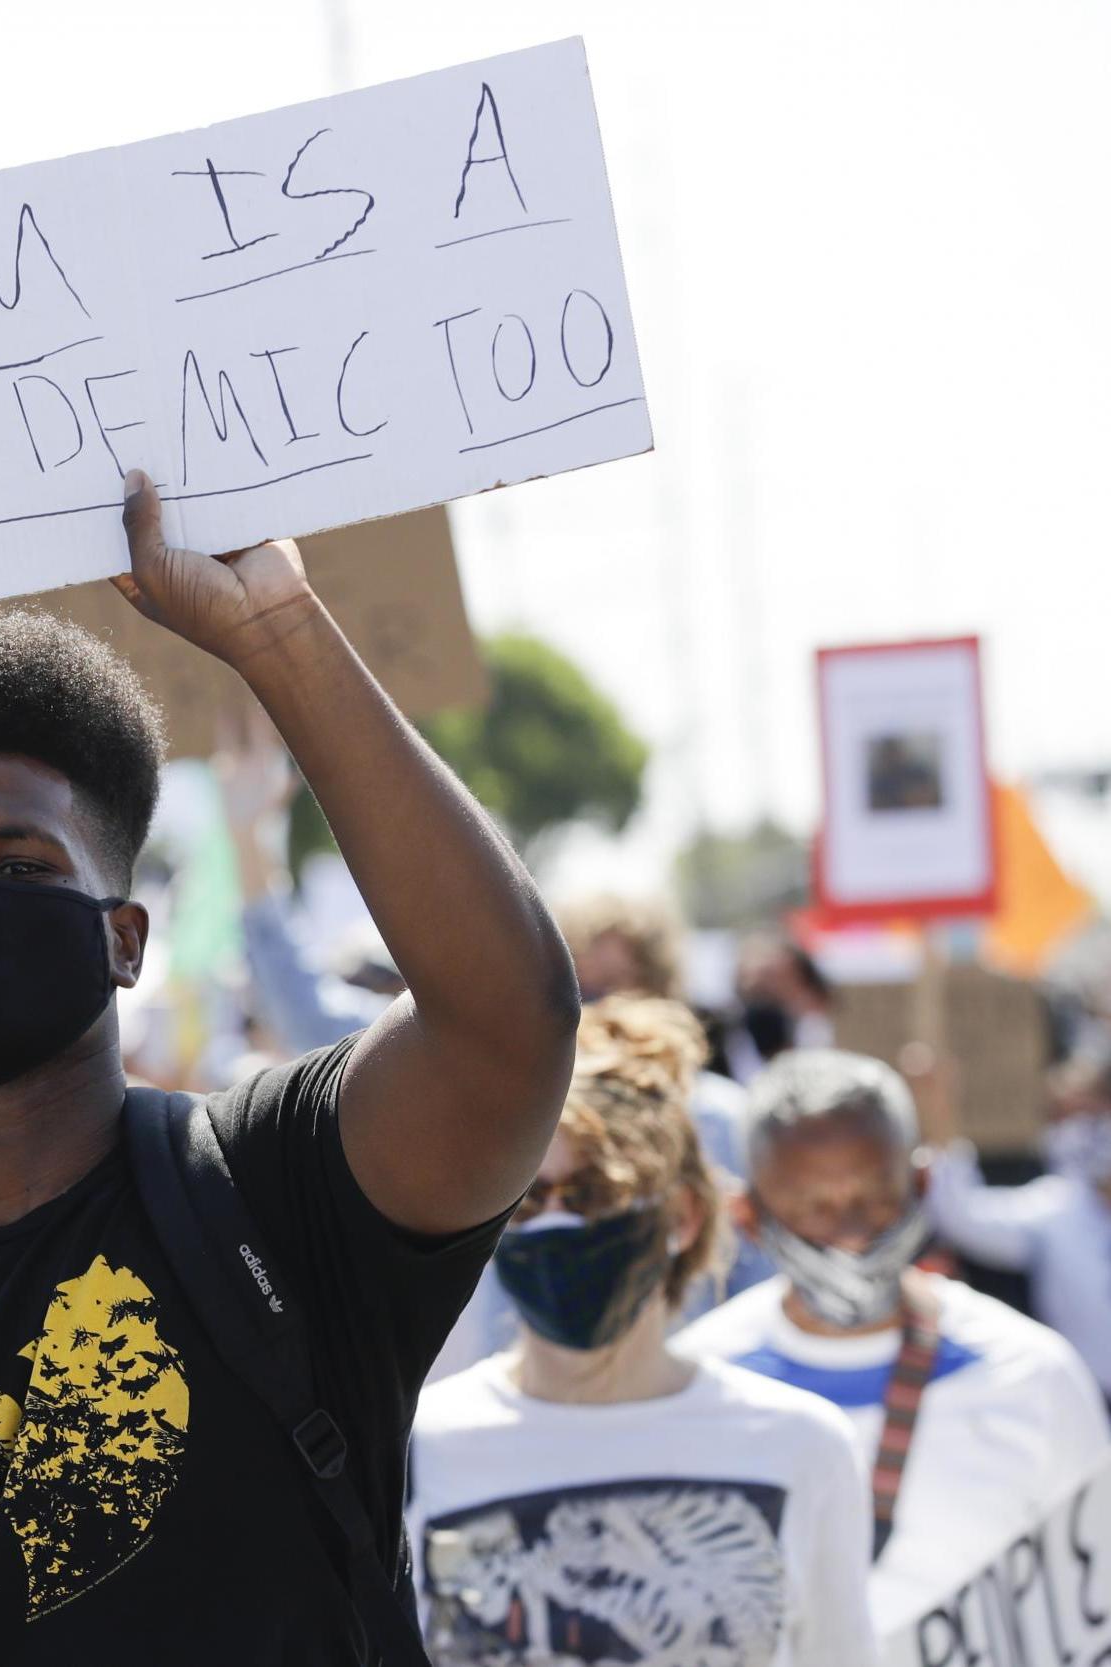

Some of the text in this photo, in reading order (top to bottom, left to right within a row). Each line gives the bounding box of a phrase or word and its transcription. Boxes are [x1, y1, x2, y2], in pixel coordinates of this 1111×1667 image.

[171, 127, 375, 260] IS
[453, 81, 528, 219] A
[433, 289, 614, 435] TOO
[238, 1244, 273, 1296] adidas
